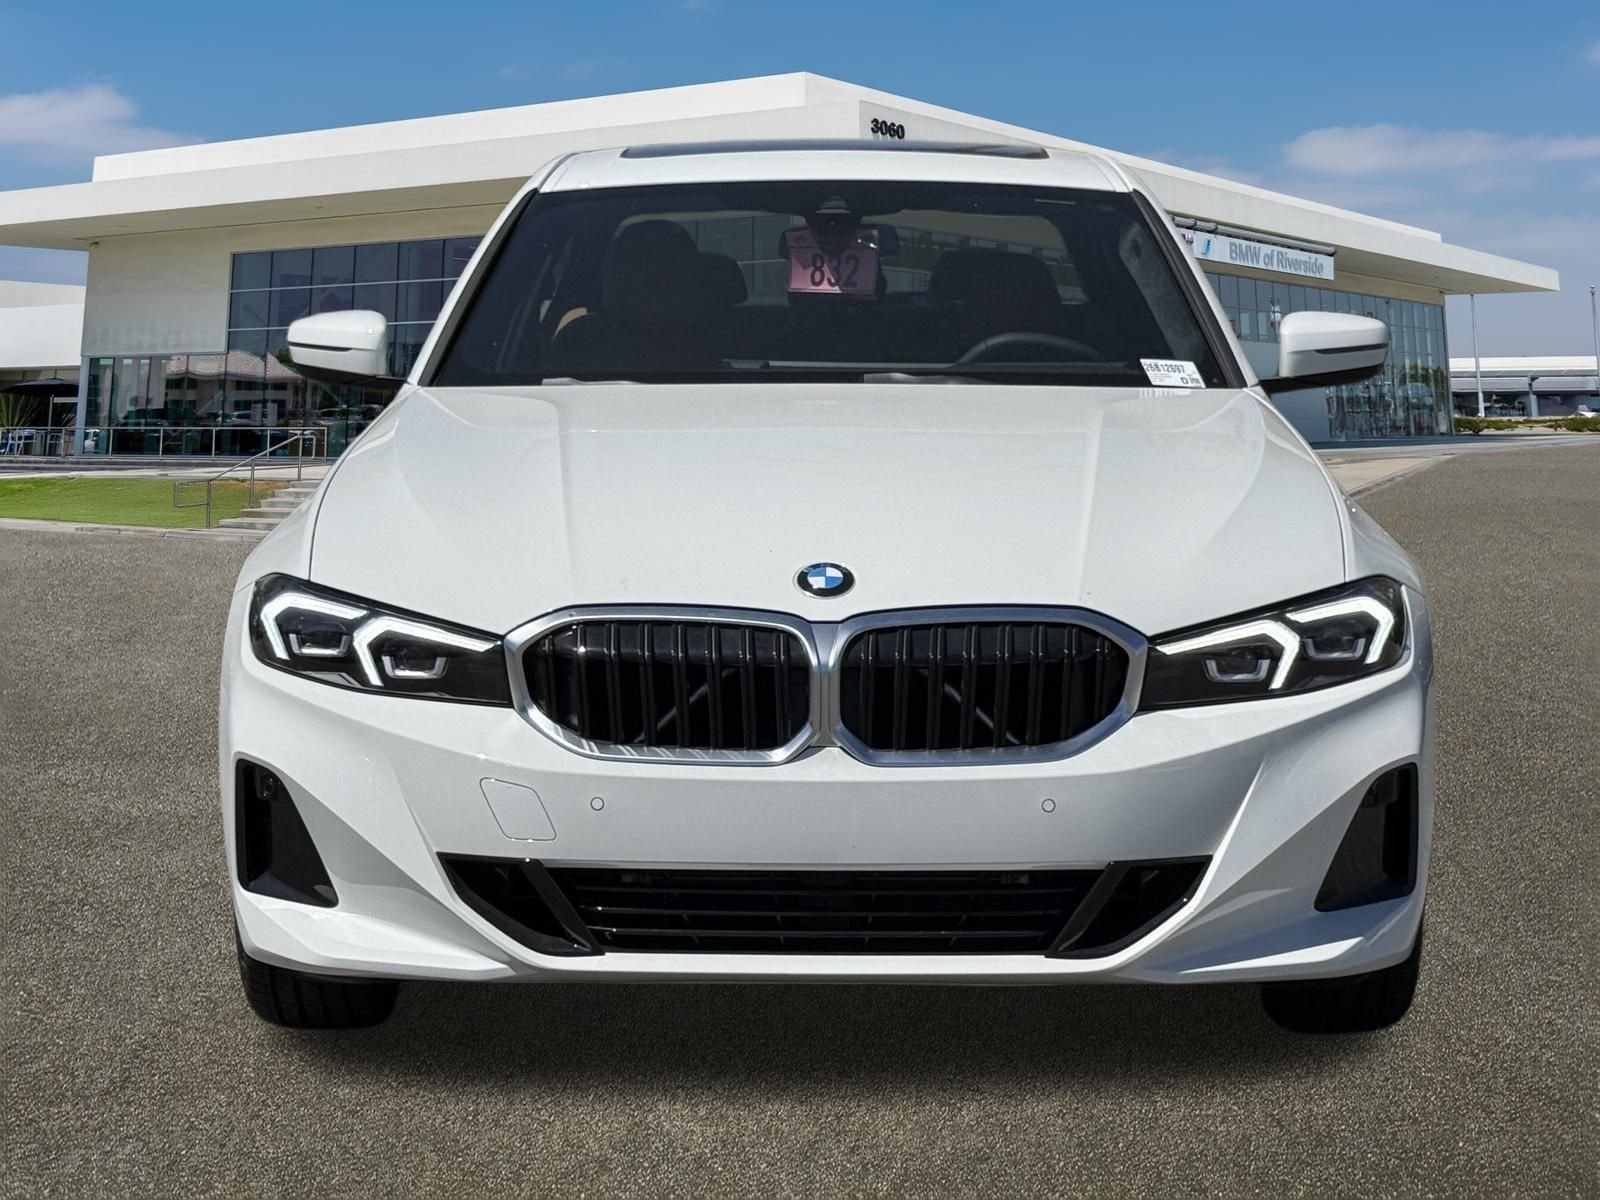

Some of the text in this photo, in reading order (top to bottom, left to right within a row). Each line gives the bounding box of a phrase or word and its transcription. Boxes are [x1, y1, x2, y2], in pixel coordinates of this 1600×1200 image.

[871, 118, 905, 139] 3060
[810, 253, 859, 288] 832
[1229, 241, 1324, 275] BMW of Riverside
